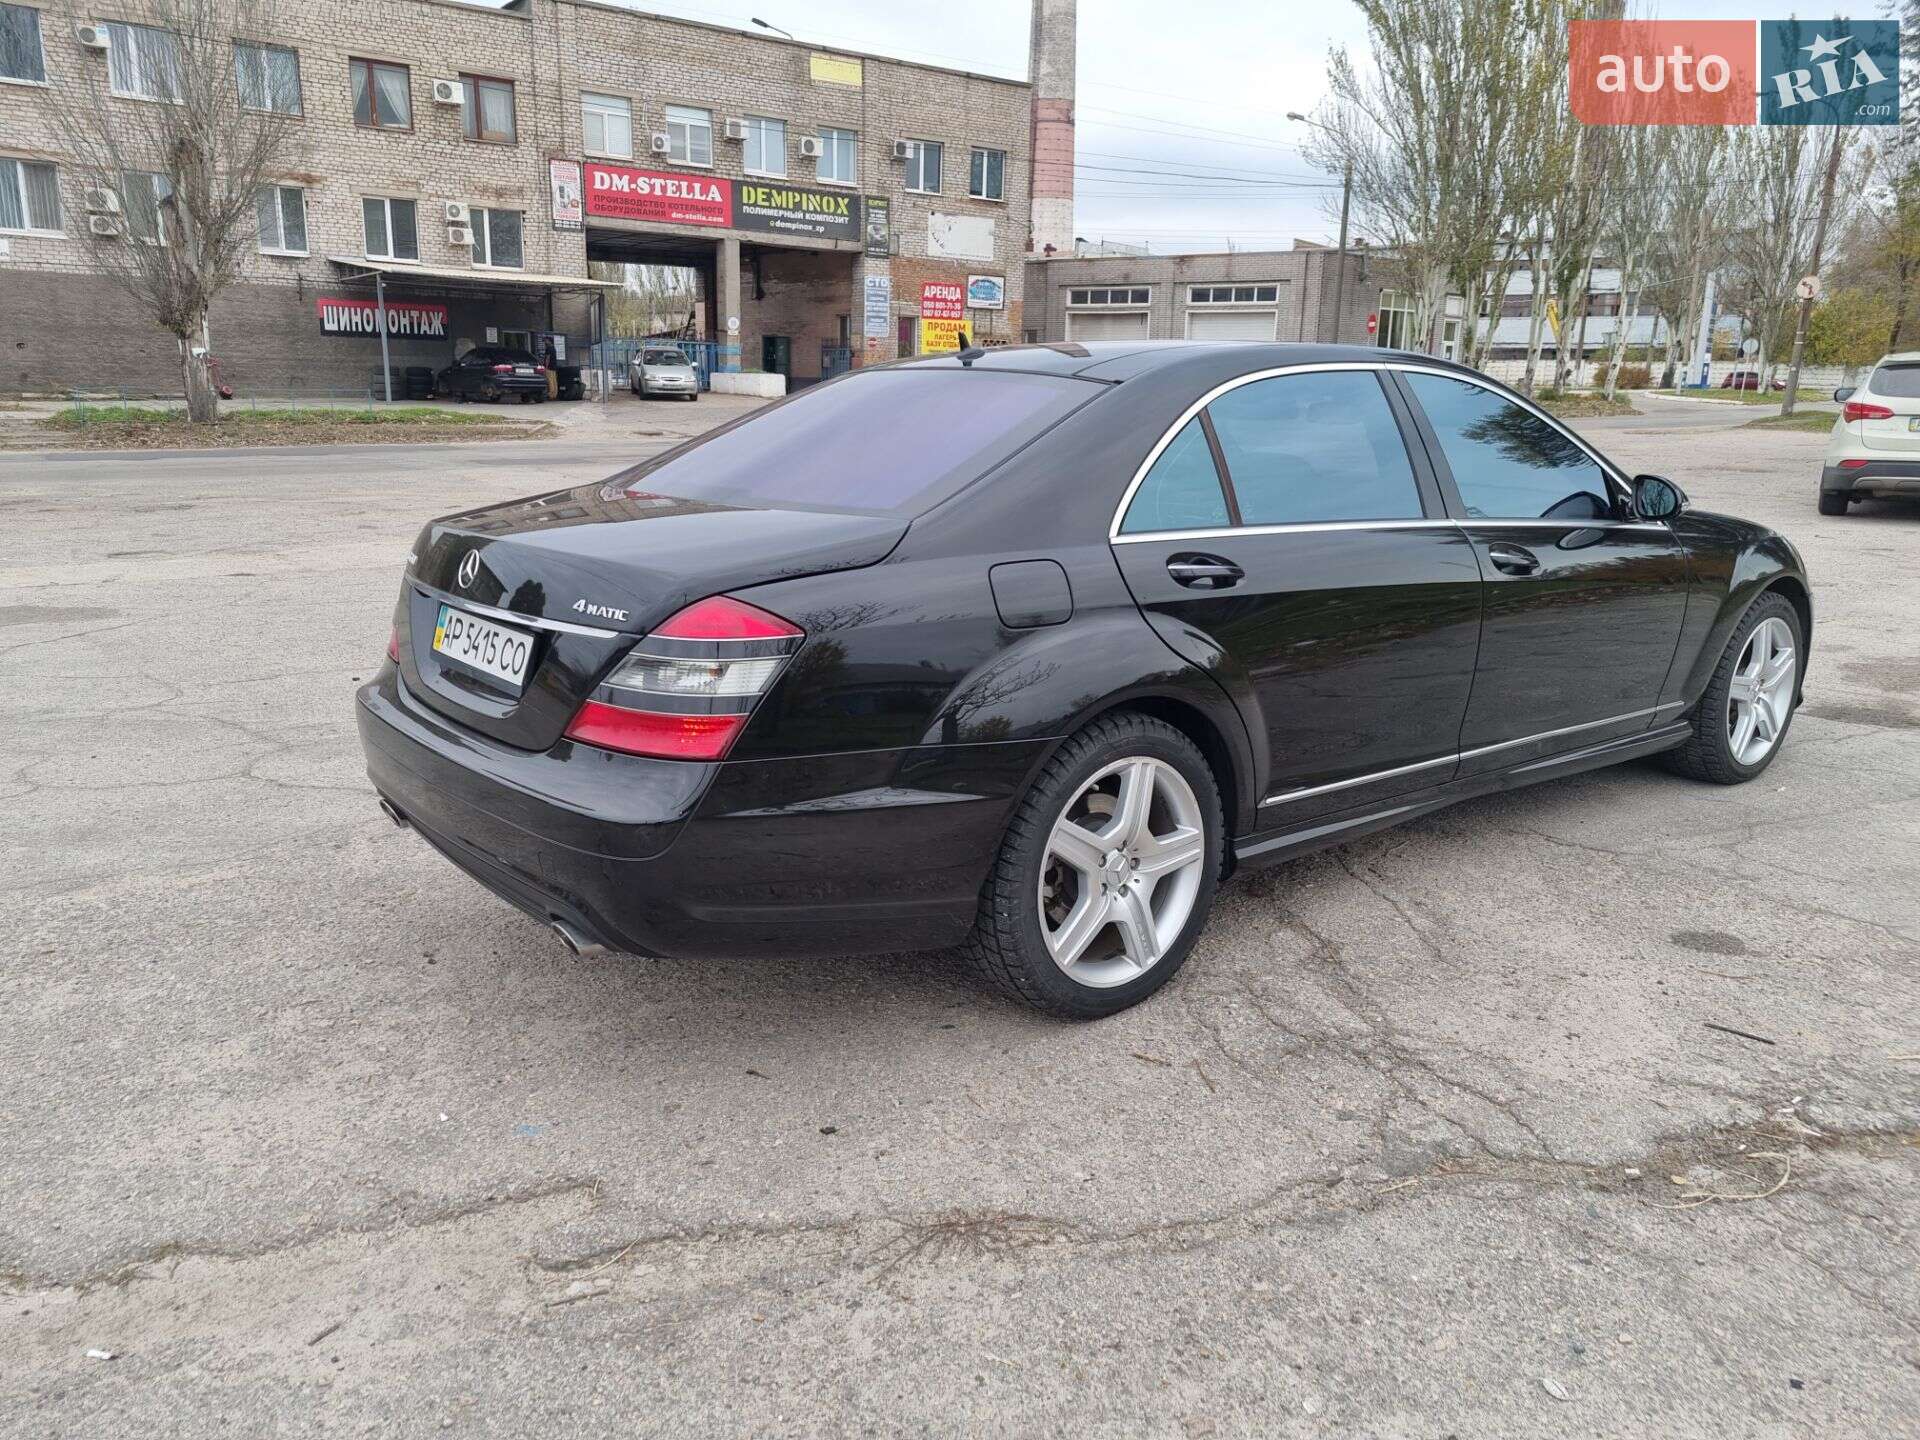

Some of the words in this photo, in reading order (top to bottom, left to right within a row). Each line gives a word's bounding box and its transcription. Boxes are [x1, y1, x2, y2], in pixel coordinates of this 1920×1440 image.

[592, 171, 723, 202] DM-STELLA
[594, 194, 666, 210] ПРОИЗВОДСТВО
[668, 202, 723, 215] КОТЕЛЬНОГО
[742, 185, 850, 215] DEMPINOX
[594, 203, 667, 217] ОБОРУДОВАНИЯ
[671, 211, 724, 223] dm-stella.com
[743, 206, 804, 219] ПОЛИМЕРНЫЙ
[805, 212, 850, 224] КОМПОЗИТ
[867, 277, 888, 287] СТО
[923, 285, 962, 301] АРЕНДА
[927, 321, 966, 333] ПРОДАМ
[442, 615, 464, 648] AP
[463, 622, 500, 665] 5415
[500, 637, 526, 675] CO
